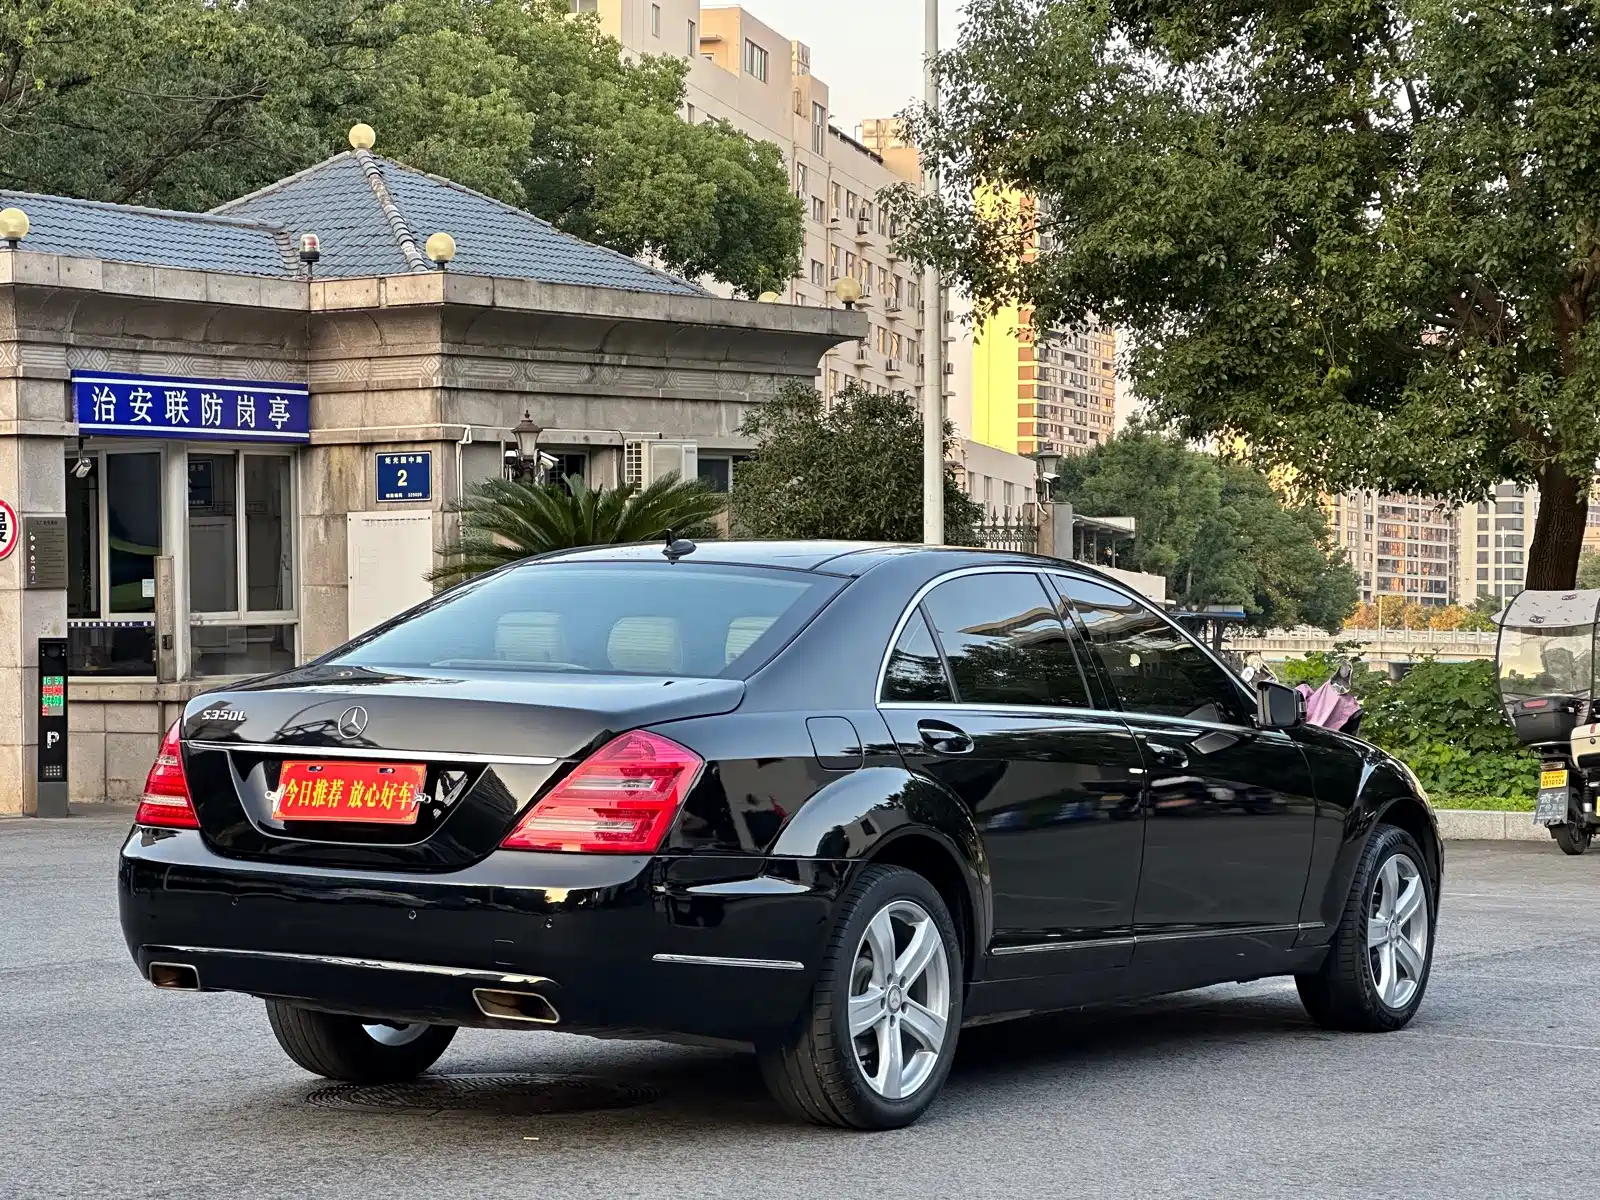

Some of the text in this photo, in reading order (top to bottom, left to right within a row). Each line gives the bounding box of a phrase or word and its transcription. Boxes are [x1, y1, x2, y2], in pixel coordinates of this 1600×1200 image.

[91, 385, 291, 430] 治安联防岗亭
[397, 469, 408, 487] 2
[201, 709, 246, 721] S350L
[46, 731, 60, 749] P
[285, 778, 415, 810] 今日推荐 放心好车
